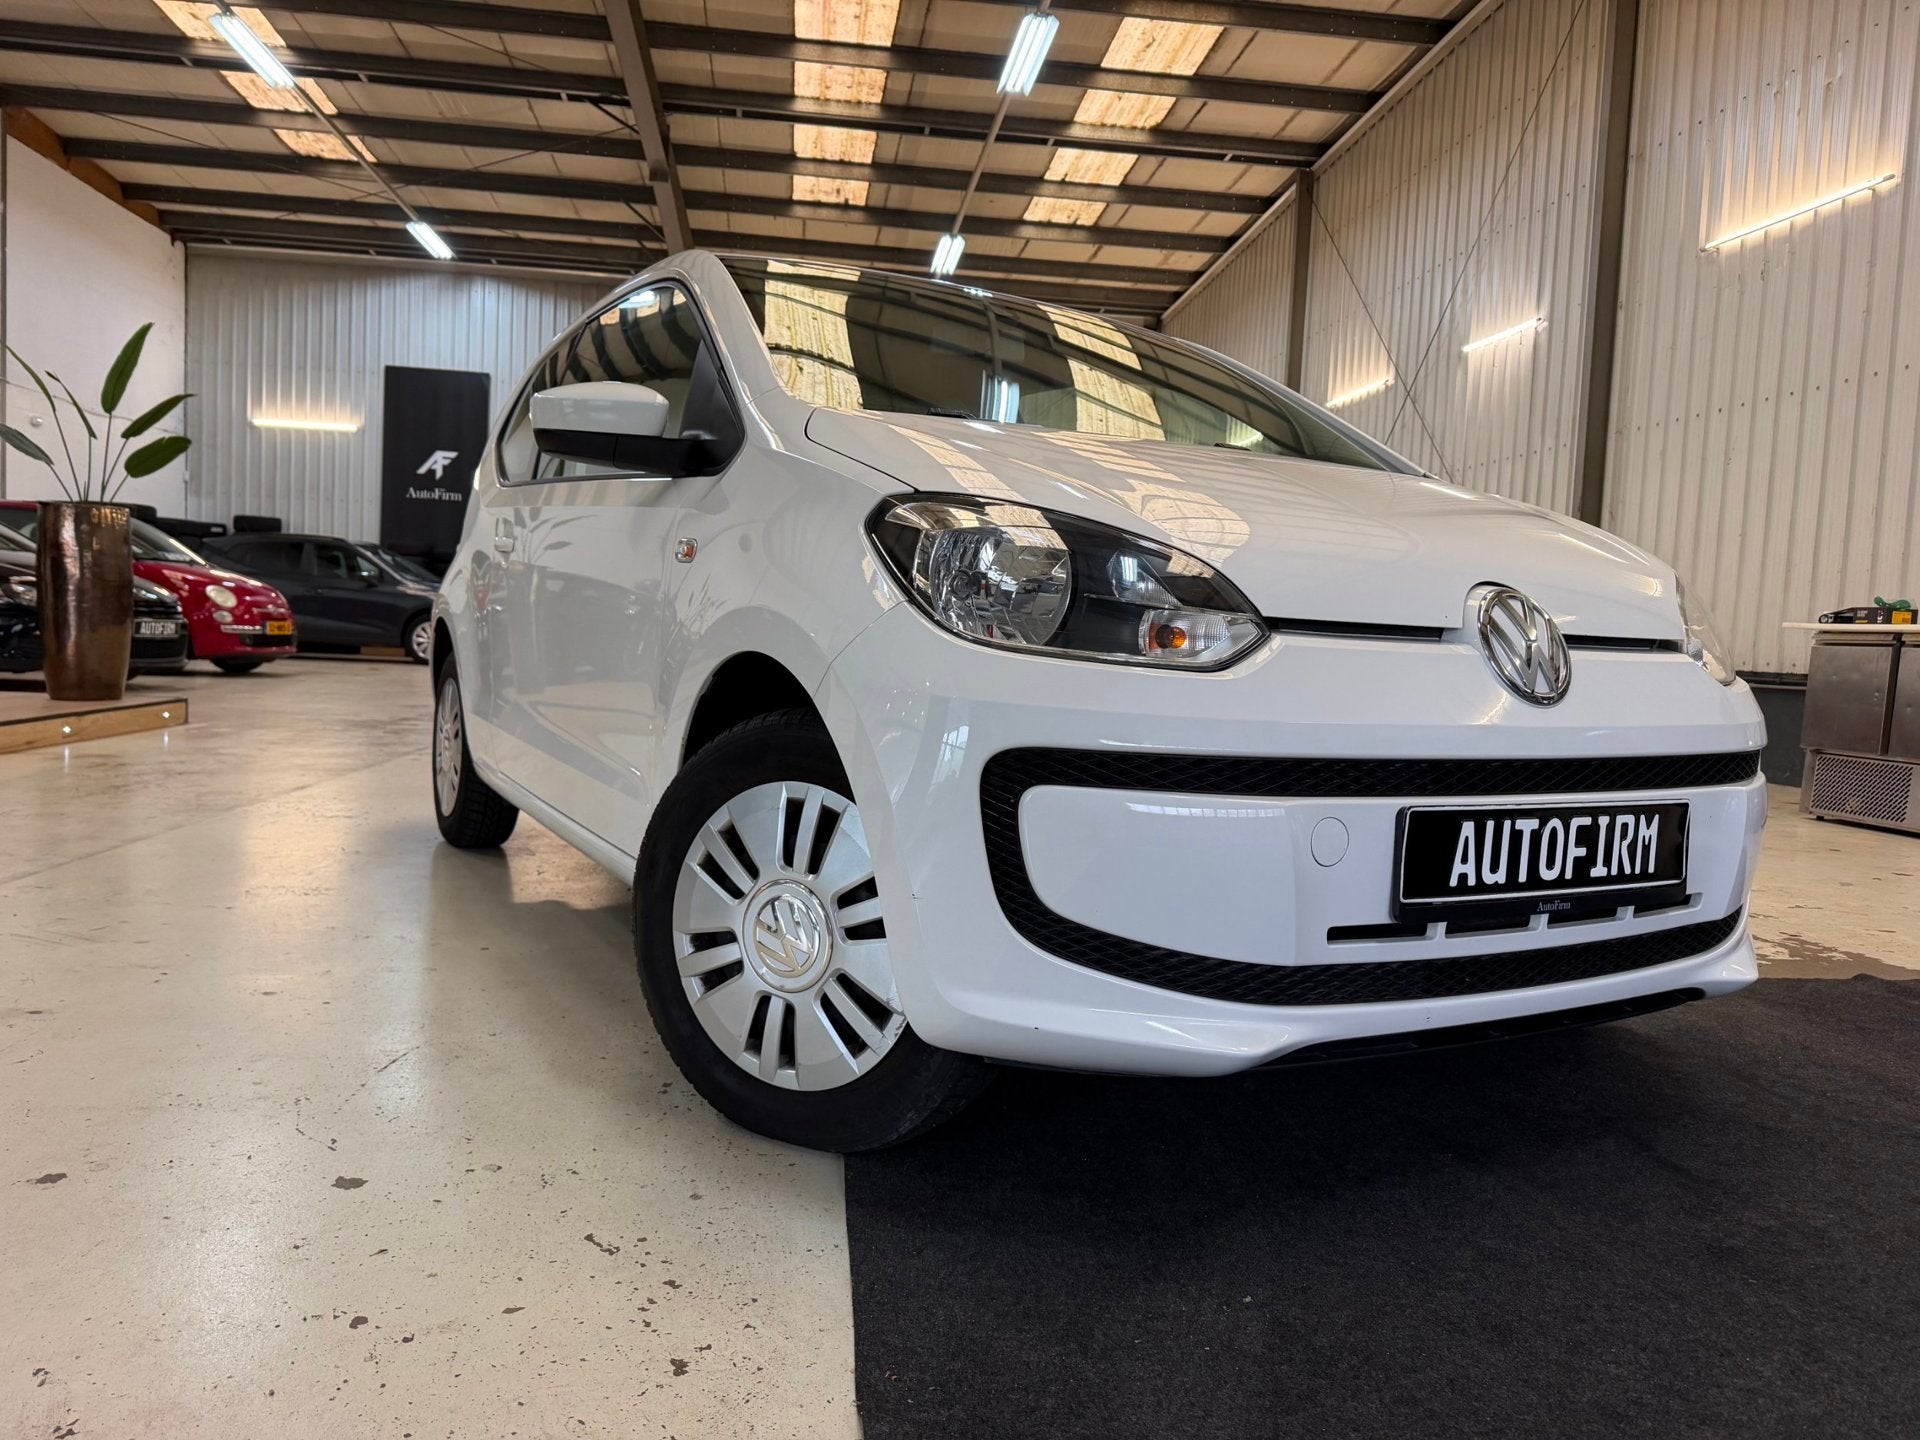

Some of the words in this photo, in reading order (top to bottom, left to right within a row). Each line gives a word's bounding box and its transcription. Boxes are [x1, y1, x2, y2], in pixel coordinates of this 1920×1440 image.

[405, 487, 462, 501] AutoFirm
[139, 621, 176, 634] AUTOFIRM
[1449, 813, 1660, 888] AUTOFIRM
[1536, 900, 1571, 912] AutoFirm
